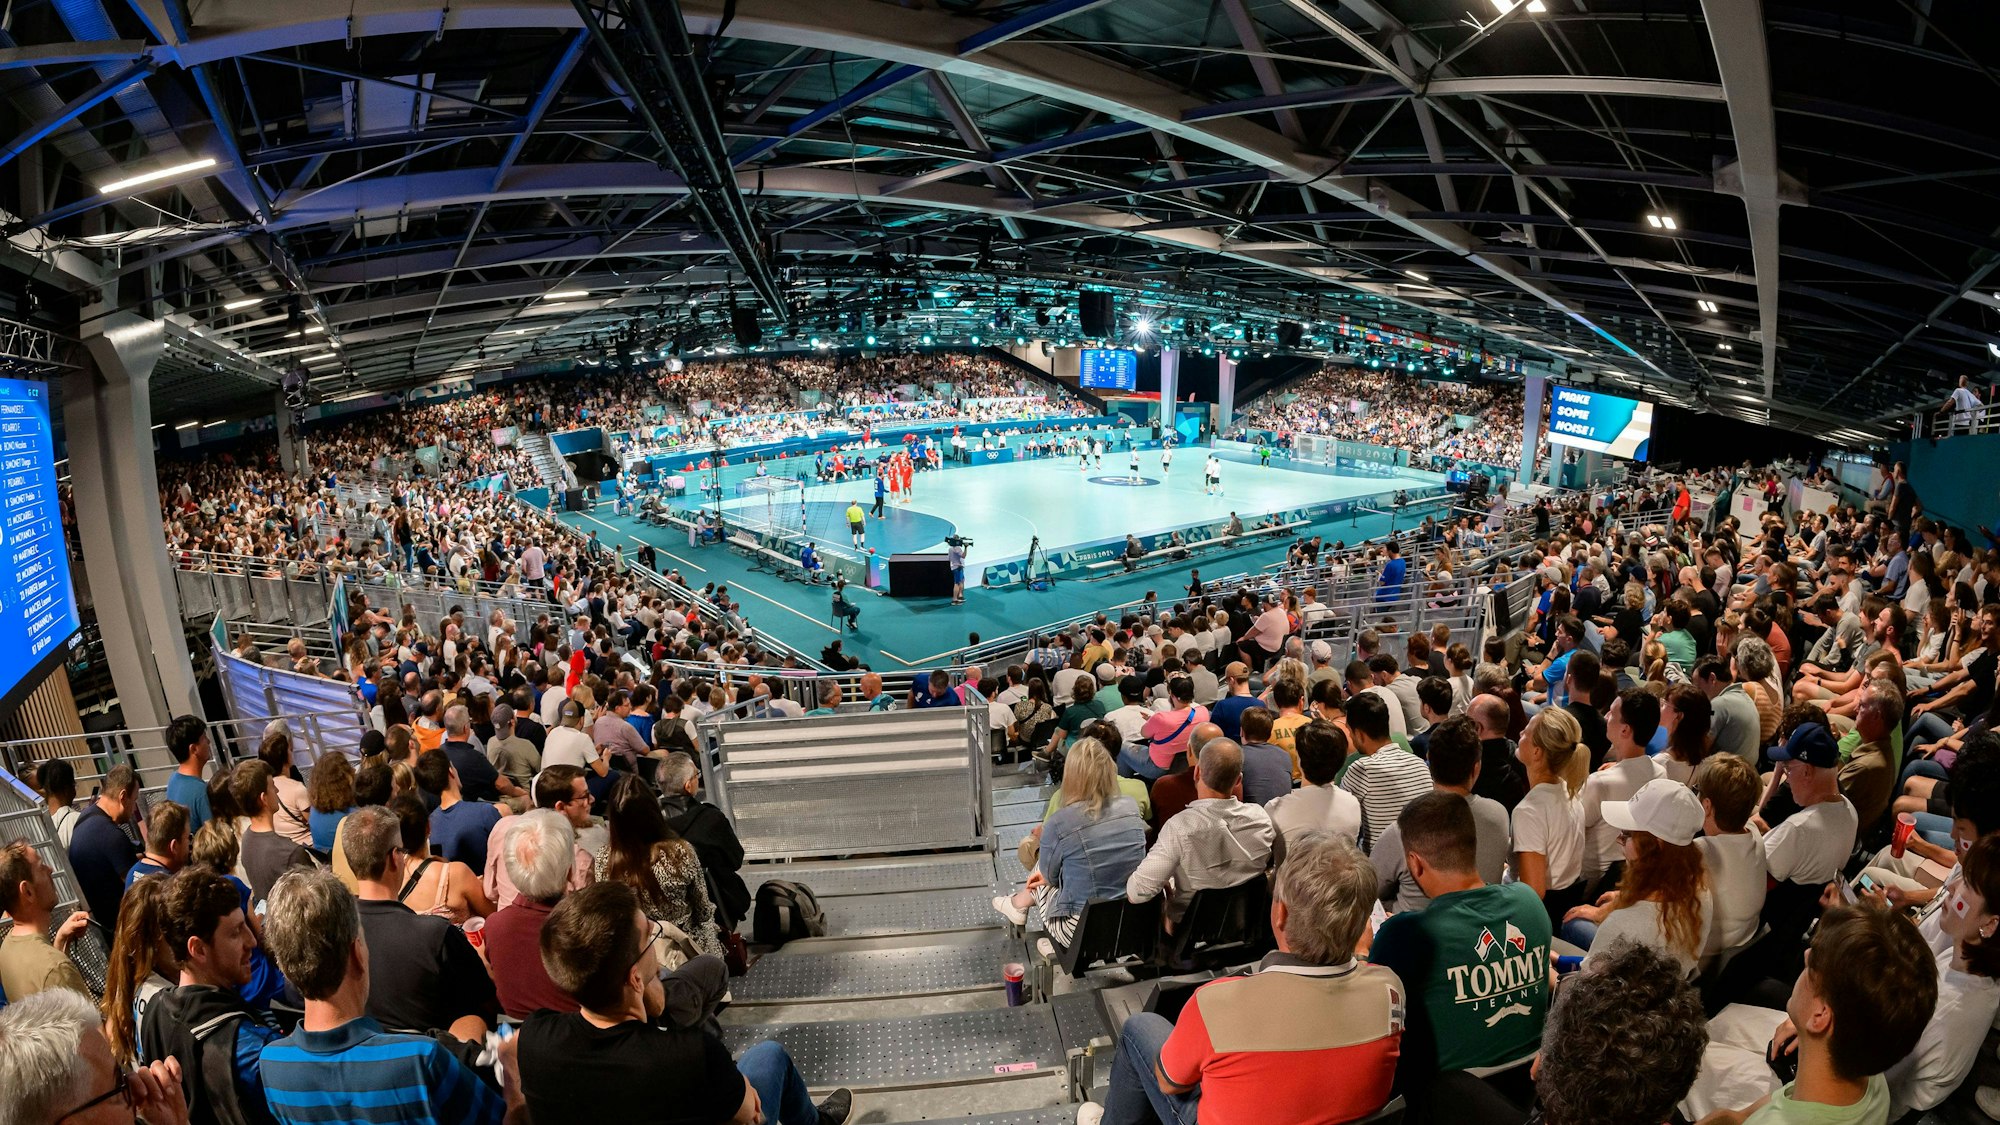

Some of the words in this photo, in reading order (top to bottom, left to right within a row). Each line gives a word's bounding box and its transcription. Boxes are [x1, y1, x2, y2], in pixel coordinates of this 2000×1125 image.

[1558, 391, 1591, 405] MAKE
[1557, 406, 1590, 420] SOME
[1555, 420, 1589, 436] NOISE
[1080, 553, 1097, 561] PARIS
[1098, 550, 1114, 558] 2024
[1447, 945, 1545, 1000] TOMMY
[1473, 986, 1538, 1011] JEANS
